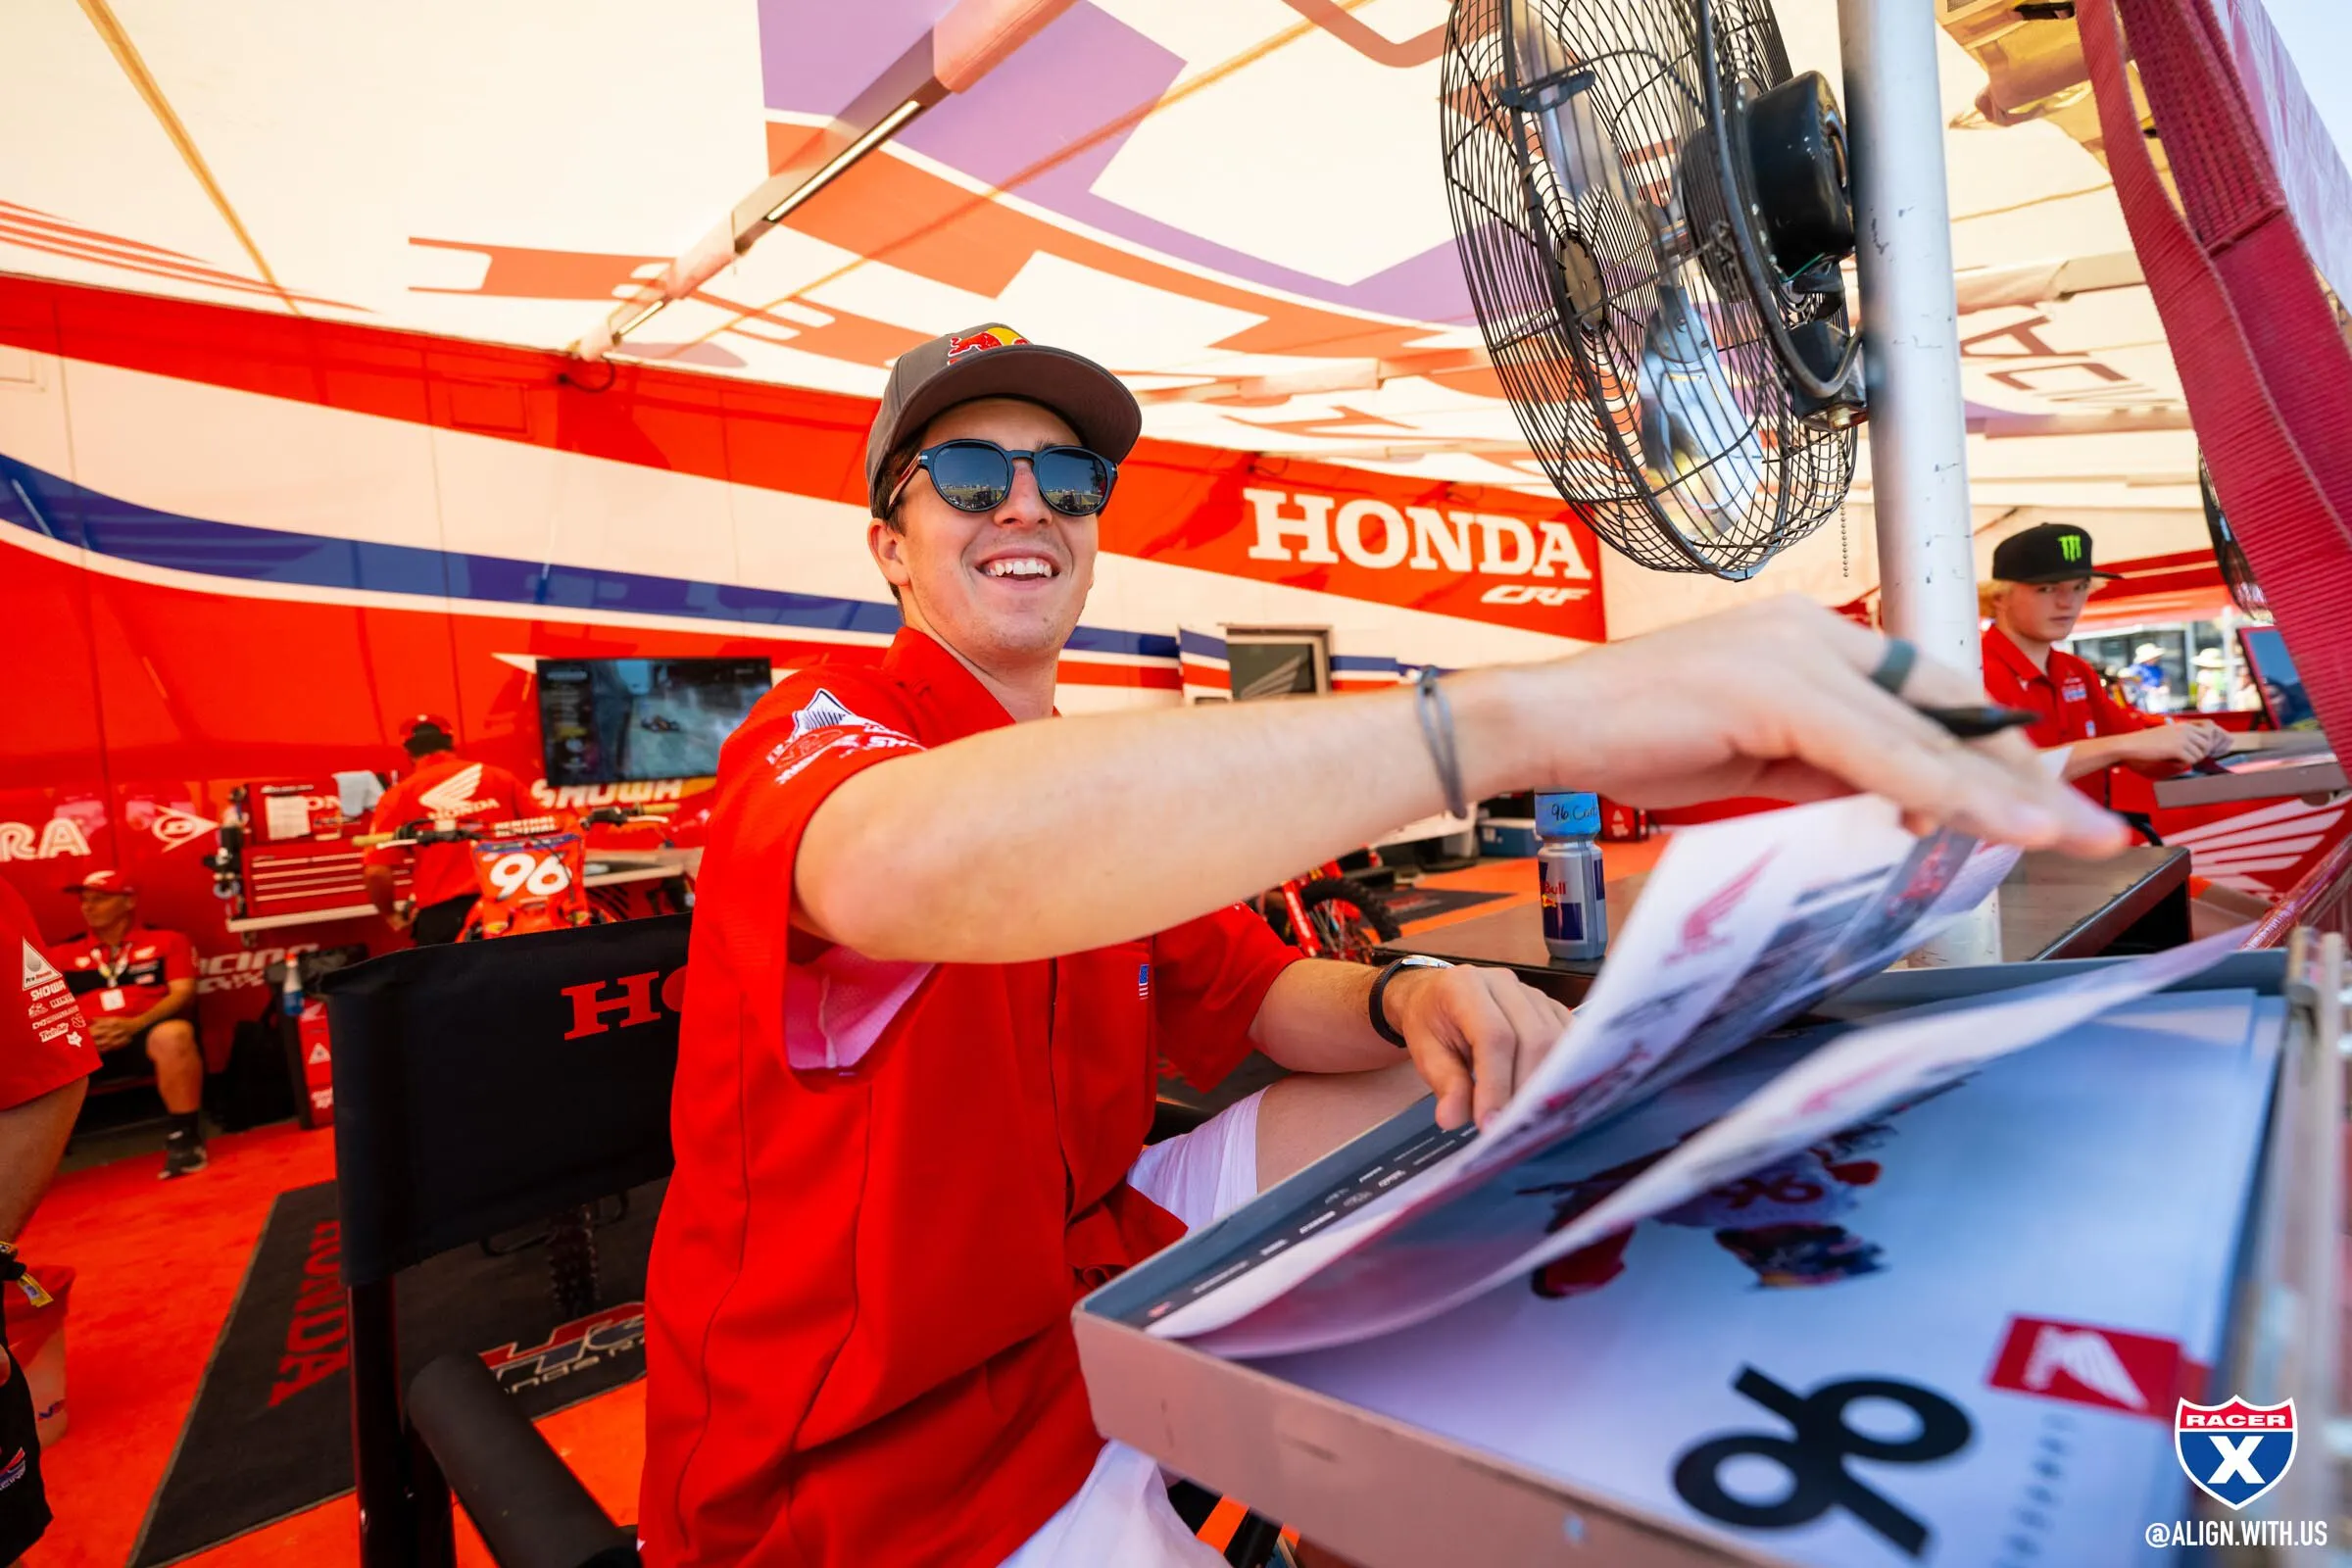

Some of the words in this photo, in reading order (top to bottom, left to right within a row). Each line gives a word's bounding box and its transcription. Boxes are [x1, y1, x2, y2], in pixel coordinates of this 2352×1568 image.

[1243, 488, 1592, 580] HONDA
[1480, 584, 1591, 607] CRF
[1551, 803, 1569, 821] 96
[490, 852, 572, 901] 96
[1544, 882, 1566, 895] Bull
[30, 979, 67, 1002] SHOWA
[1675, 1363, 1974, 1559] 96
